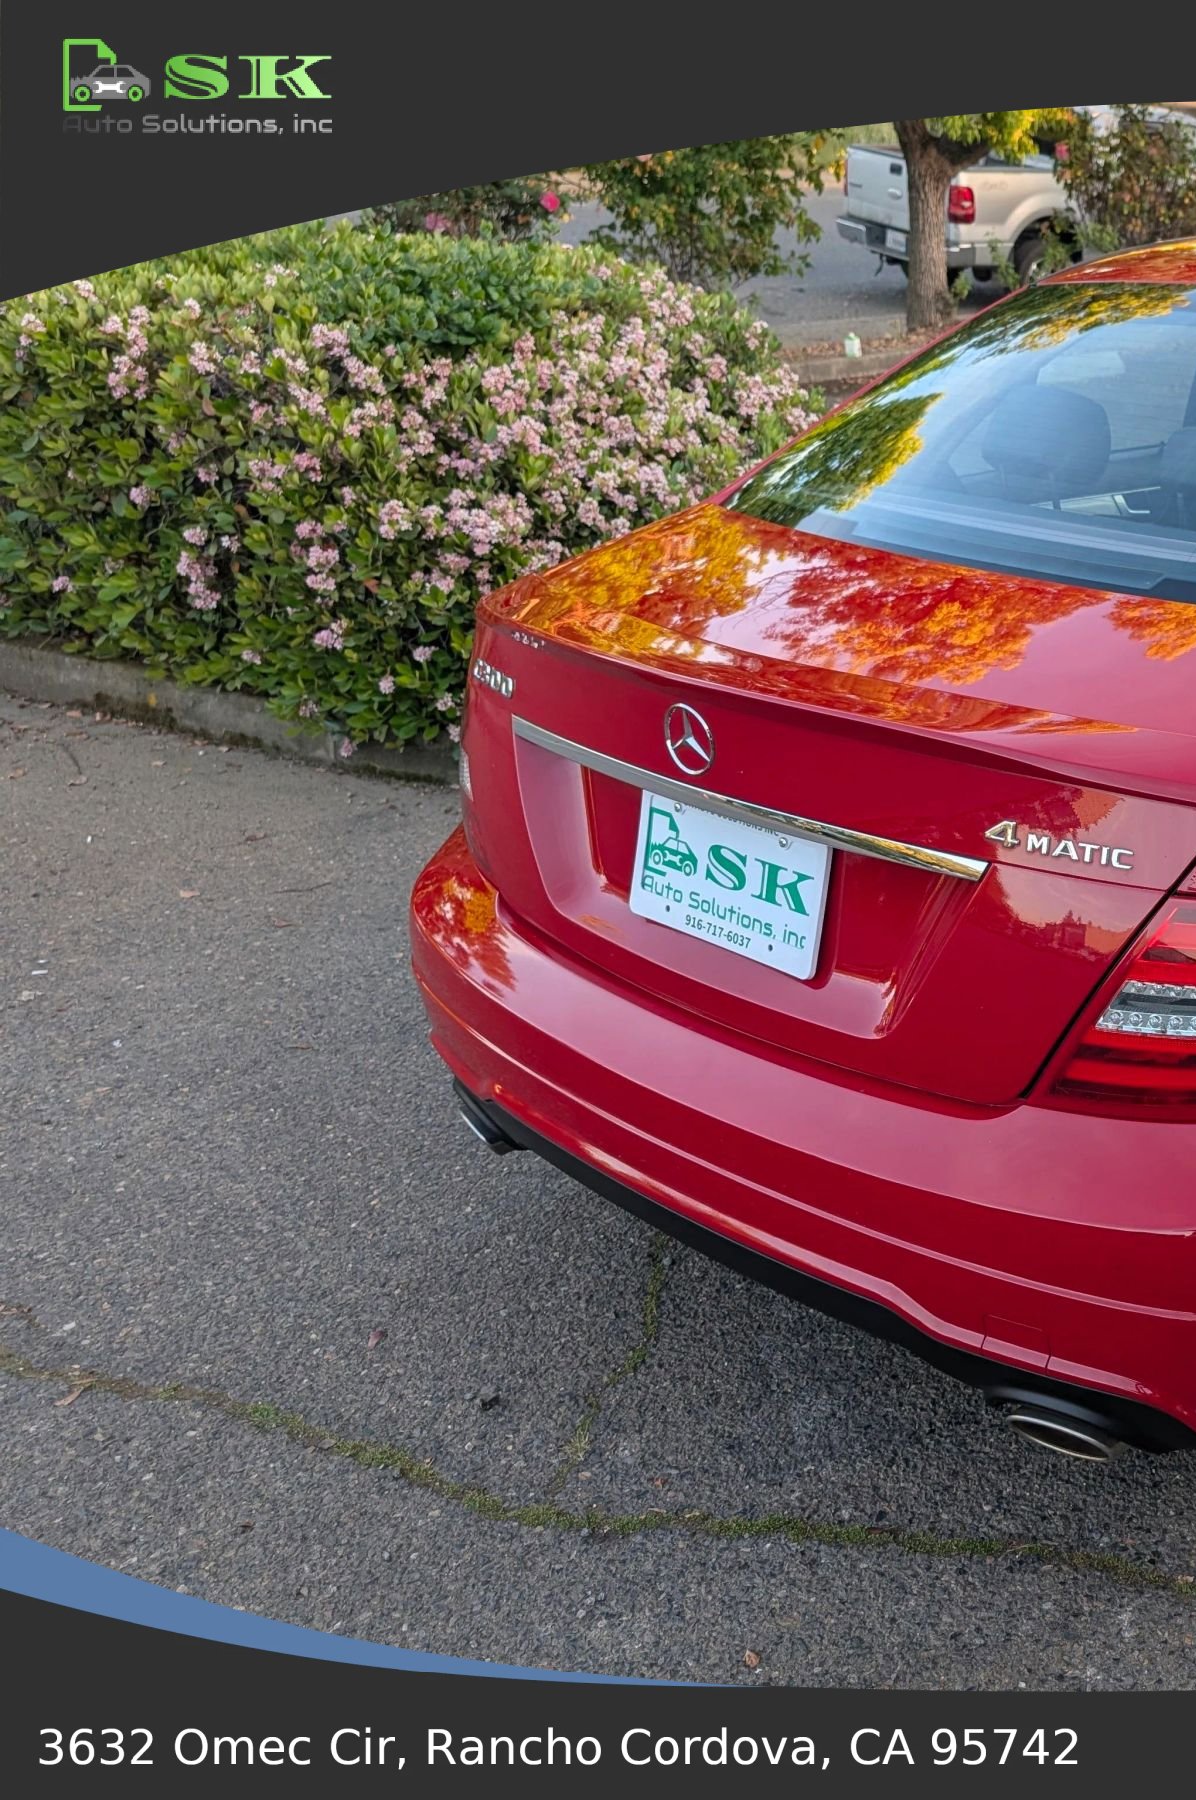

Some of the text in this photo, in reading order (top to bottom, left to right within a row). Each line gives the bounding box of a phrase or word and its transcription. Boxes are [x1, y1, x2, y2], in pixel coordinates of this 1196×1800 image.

[641, 873, 684, 904] Auto
[688, 890, 777, 939] Solutions,
[705, 844, 815, 917] SK
[685, 914, 752, 949] 916-717-6037
